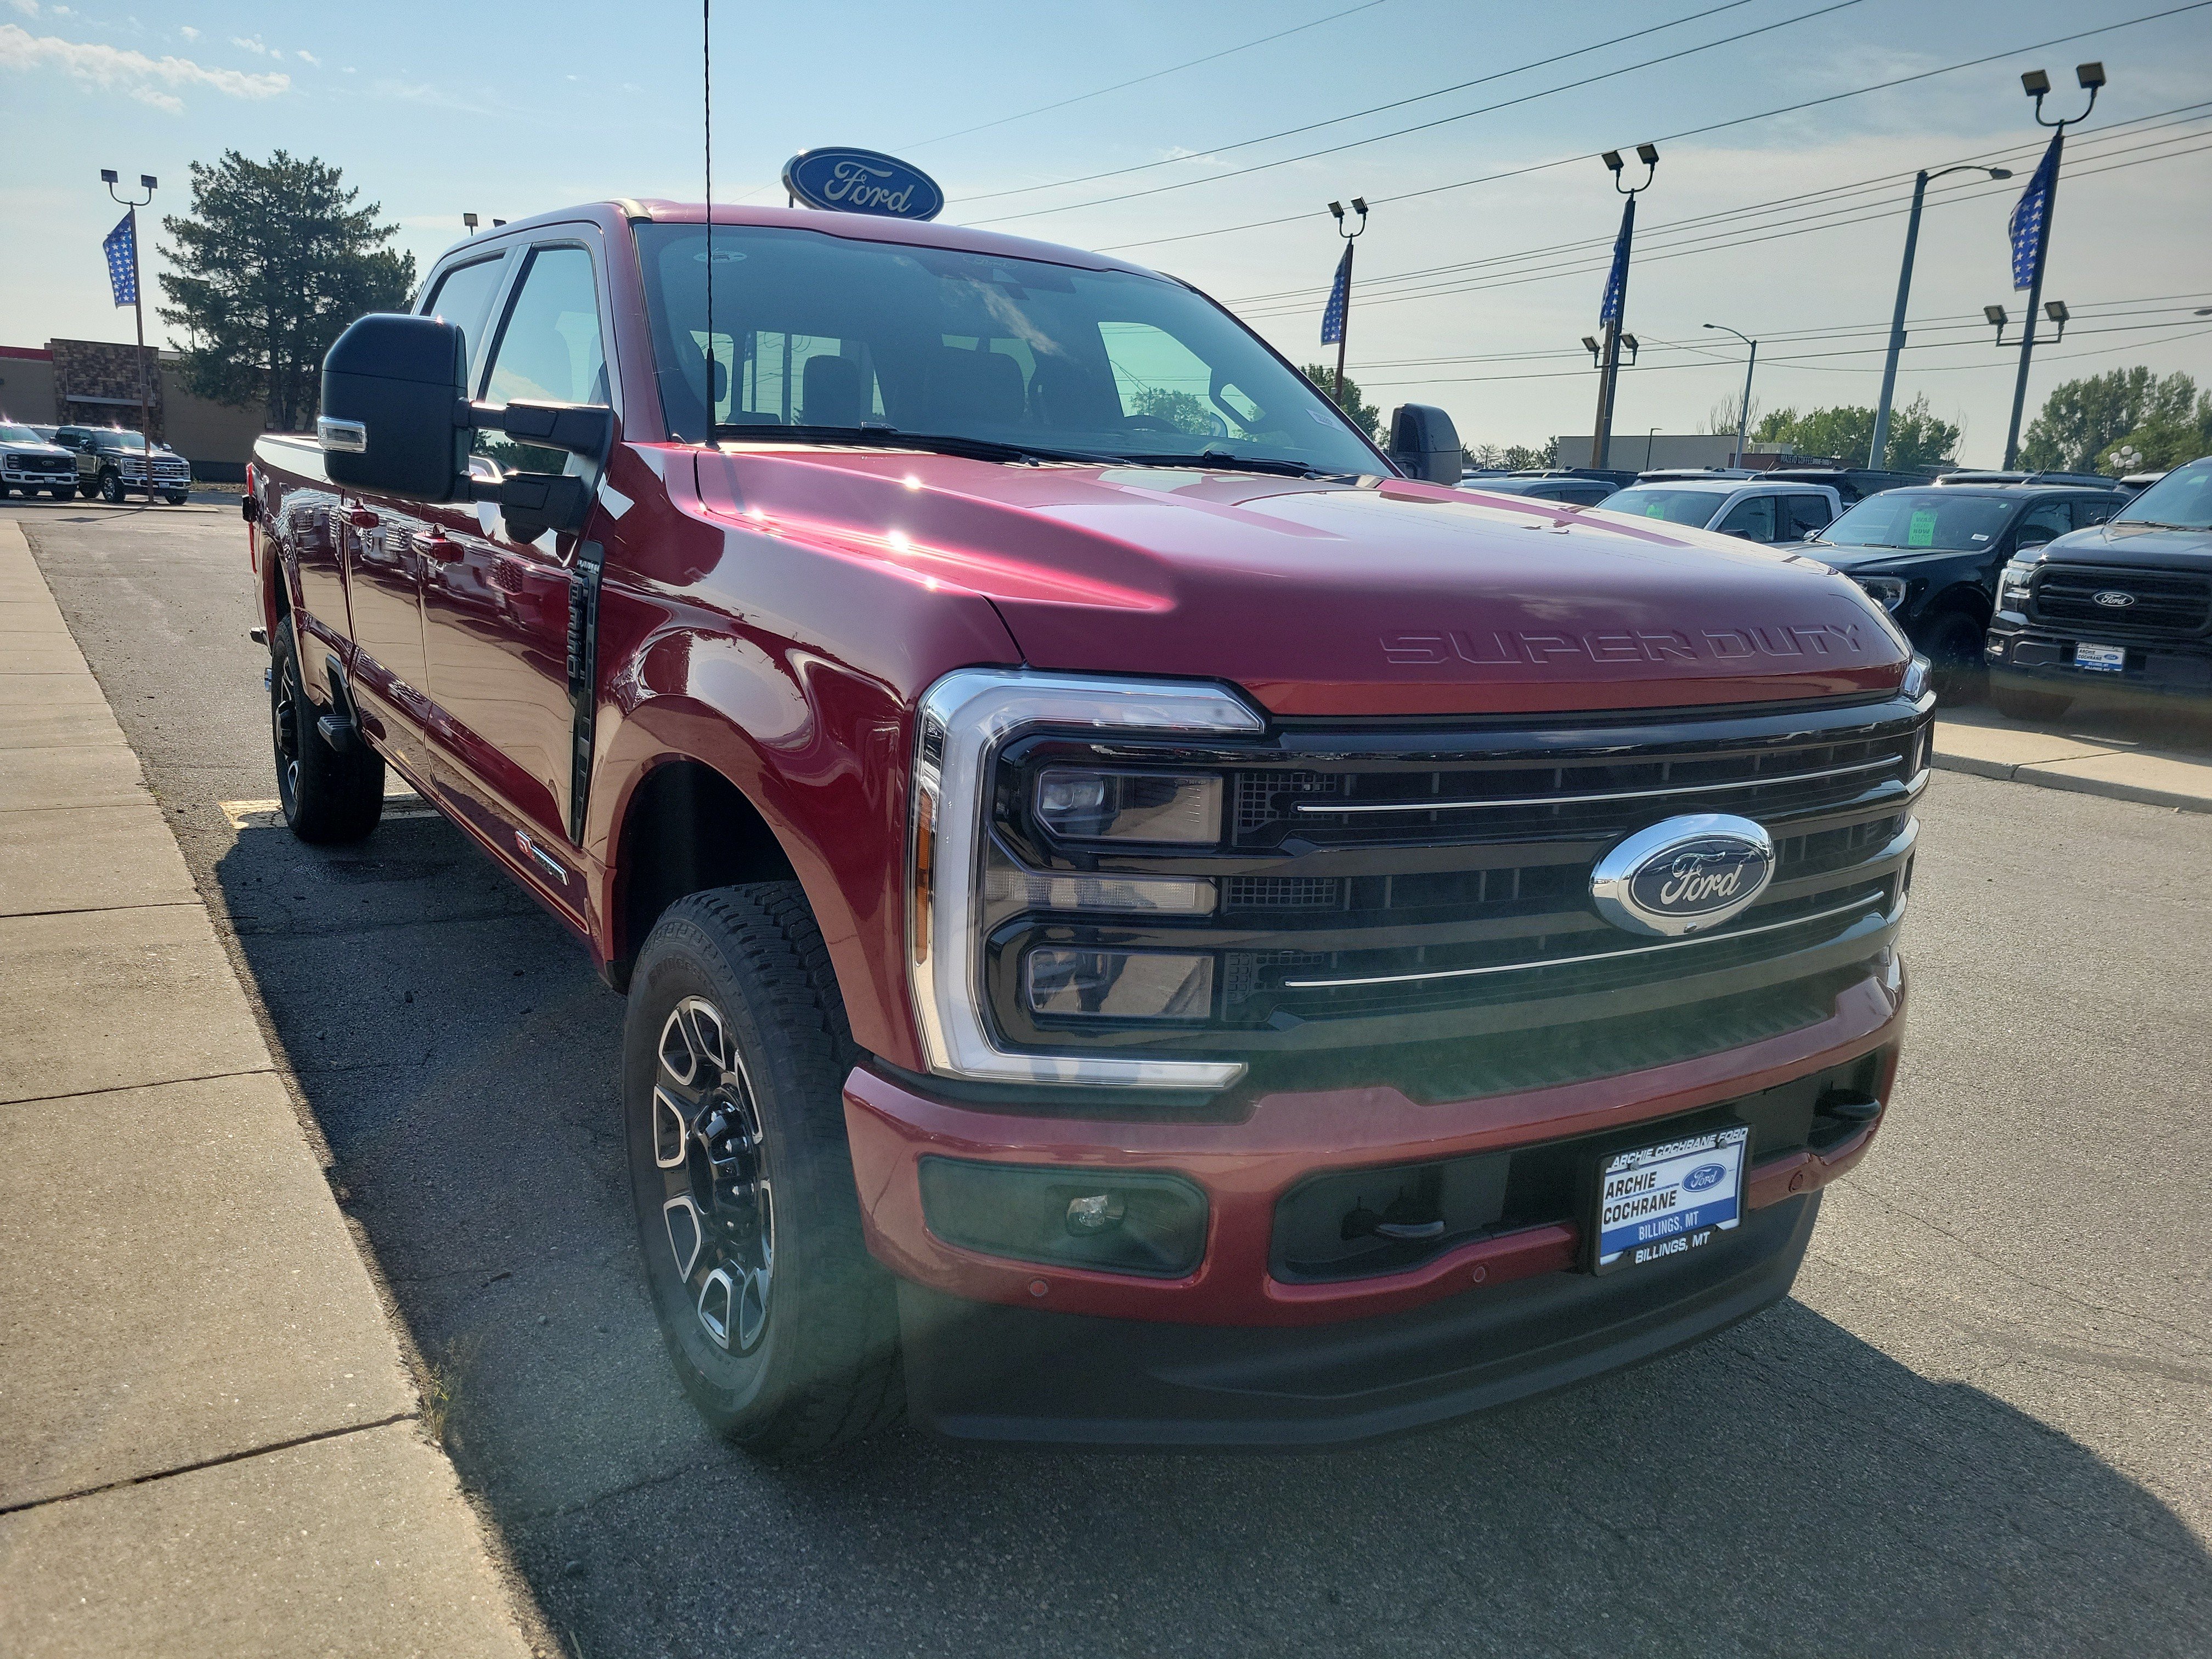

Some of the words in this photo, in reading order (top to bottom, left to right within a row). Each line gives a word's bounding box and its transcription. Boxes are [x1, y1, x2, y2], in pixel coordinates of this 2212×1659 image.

[824, 161, 915, 213] Ford
[2101, 594, 2127, 605] Ford
[1380, 629, 1699, 664] SUPER
[1701, 624, 1860, 658] DUTY
[1661, 851, 1745, 905] Ford
[1611, 1149, 1654, 1168] ARCHIE
[1655, 1134, 1716, 1157] COCHRANE
[1718, 1127, 1748, 1143] FORD
[1605, 1171, 1657, 1200] ARCHIE
[1691, 1168, 1717, 1188] Ford
[1603, 1189, 1677, 1225] COCHRANE
[1638, 1216, 1683, 1241] BILLINGS,
[1685, 1211, 1699, 1228] MT
[1635, 1237, 1688, 1264] BILLINGS,
[1692, 1231, 1711, 1248] MT
